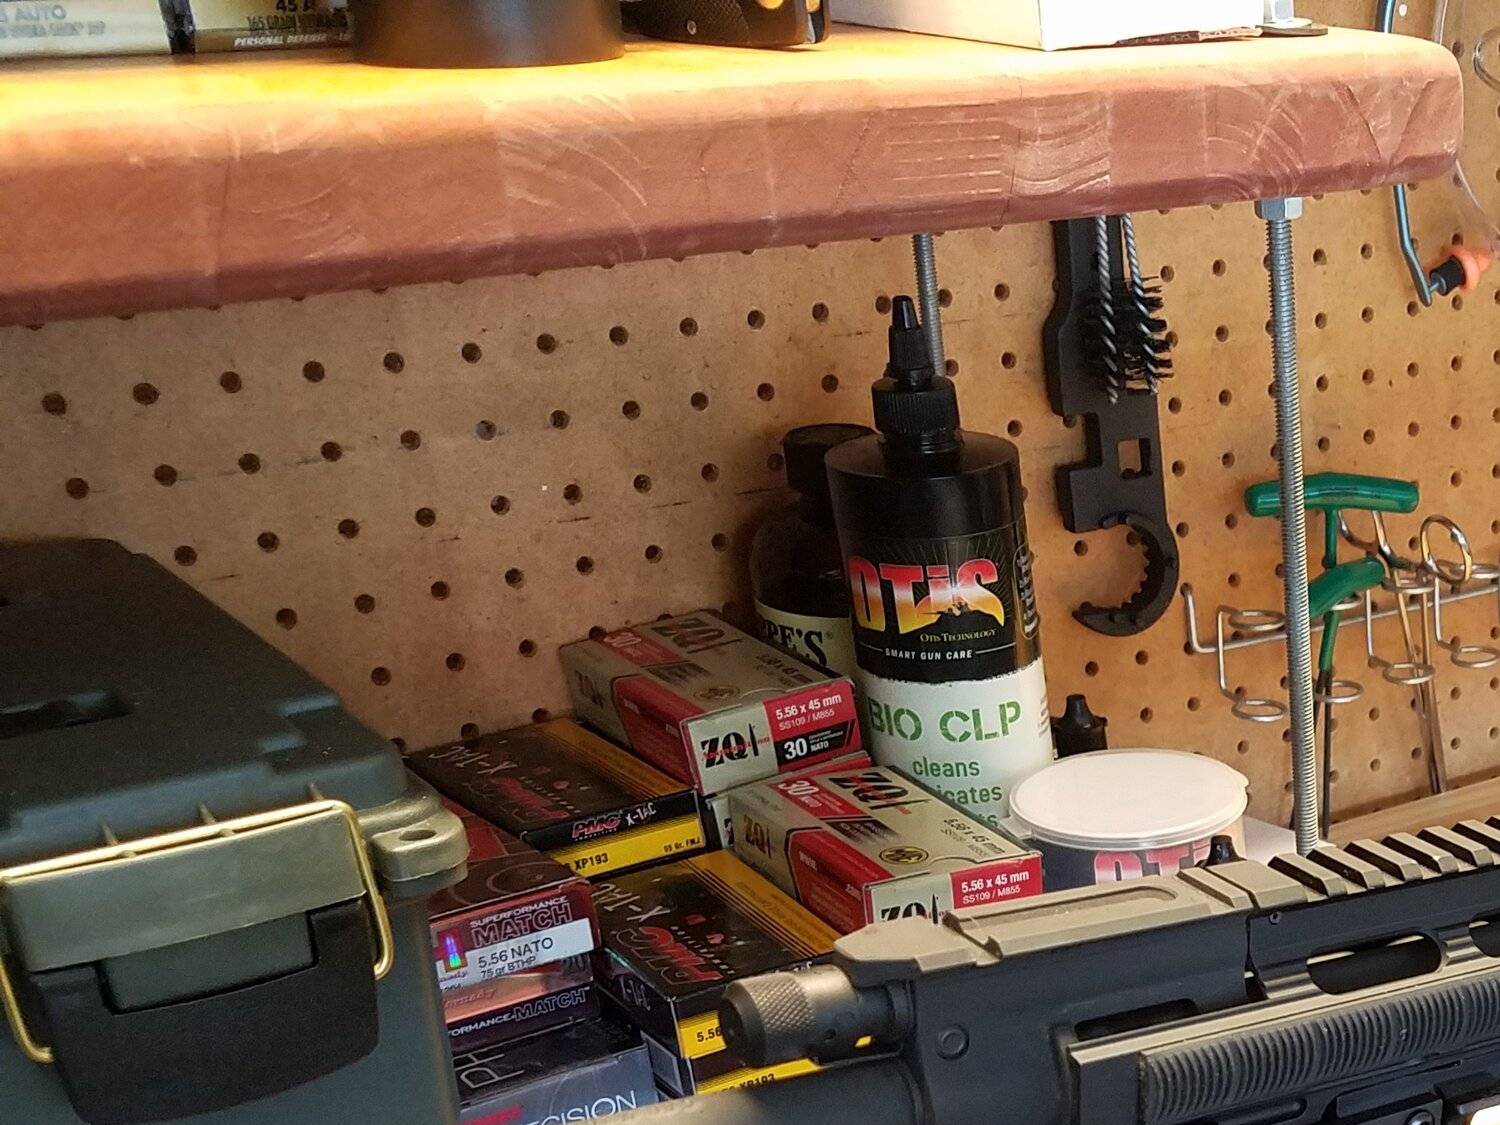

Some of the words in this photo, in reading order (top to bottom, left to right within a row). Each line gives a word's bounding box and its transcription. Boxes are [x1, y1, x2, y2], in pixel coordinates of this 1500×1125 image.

[234, 35, 284, 48] PERSONAL
[885, 648, 916, 660] SMART
[919, 649, 942, 660] GUN
[946, 649, 973, 660] CARE
[807, 697, 822, 710] 45
[823, 694, 842, 707] mm
[867, 697, 923, 741] BIO
[939, 700, 1021, 743] CLP
[783, 738, 808, 760] 30
[912, 756, 980, 777] cleans
[574, 852, 609, 871] XP193
[961, 878, 985, 893] 5.56
[994, 873, 1008, 885] 45
[1009, 870, 1029, 883] mm
[962, 891, 991, 904] SS109
[998, 885, 1021, 897] M855
[470, 895, 568, 928] SUPERFORMANCE
[471, 902, 573, 947] MATCH
[478, 950, 508, 968] 5.56
[510, 937, 554, 959] NATO
